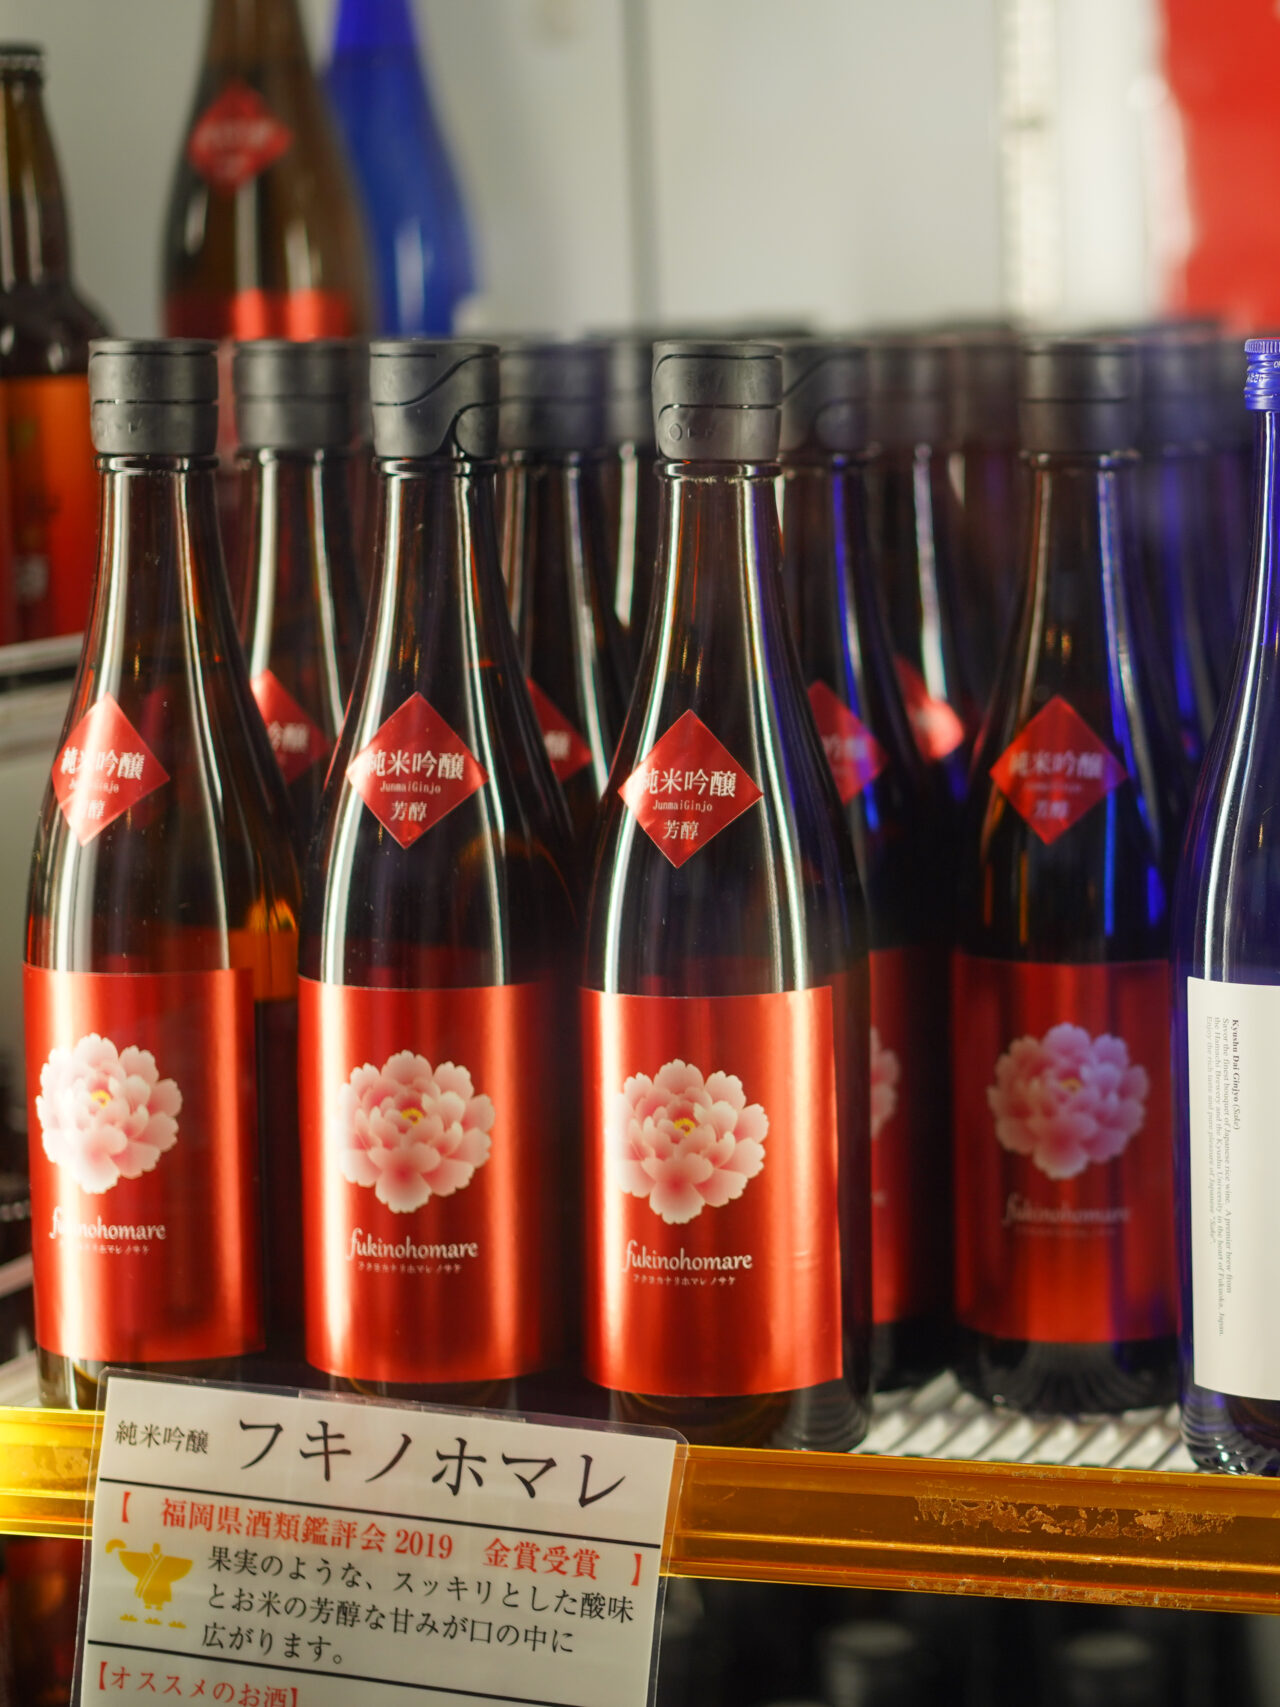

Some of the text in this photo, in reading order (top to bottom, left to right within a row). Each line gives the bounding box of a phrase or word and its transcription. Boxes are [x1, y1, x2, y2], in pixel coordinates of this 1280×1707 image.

[391, 800, 427, 822] 芳醇
[652, 799, 713, 813] JunmaiGinjo
[663, 819, 699, 840] 芳醇
[1231, 1019, 1241, 1130] Kyushu Dai Ginjyo (Sake)
[346, 1227, 478, 1260] fukinohomare
[620, 1240, 752, 1272] fukinohomare
[115, 1419, 626, 1508] 純米吟醸 フキノホマレ
[394, 1529, 453, 1560] 2019
[483, 1537, 601, 1580] 金賞受賞
[208, 1545, 634, 1623] 果実のような、スッキリとした酸味
[207, 1585, 574, 1653] とお米の芳醇な甘みが口の中に
[202, 1623, 344, 1666] 広がります。
